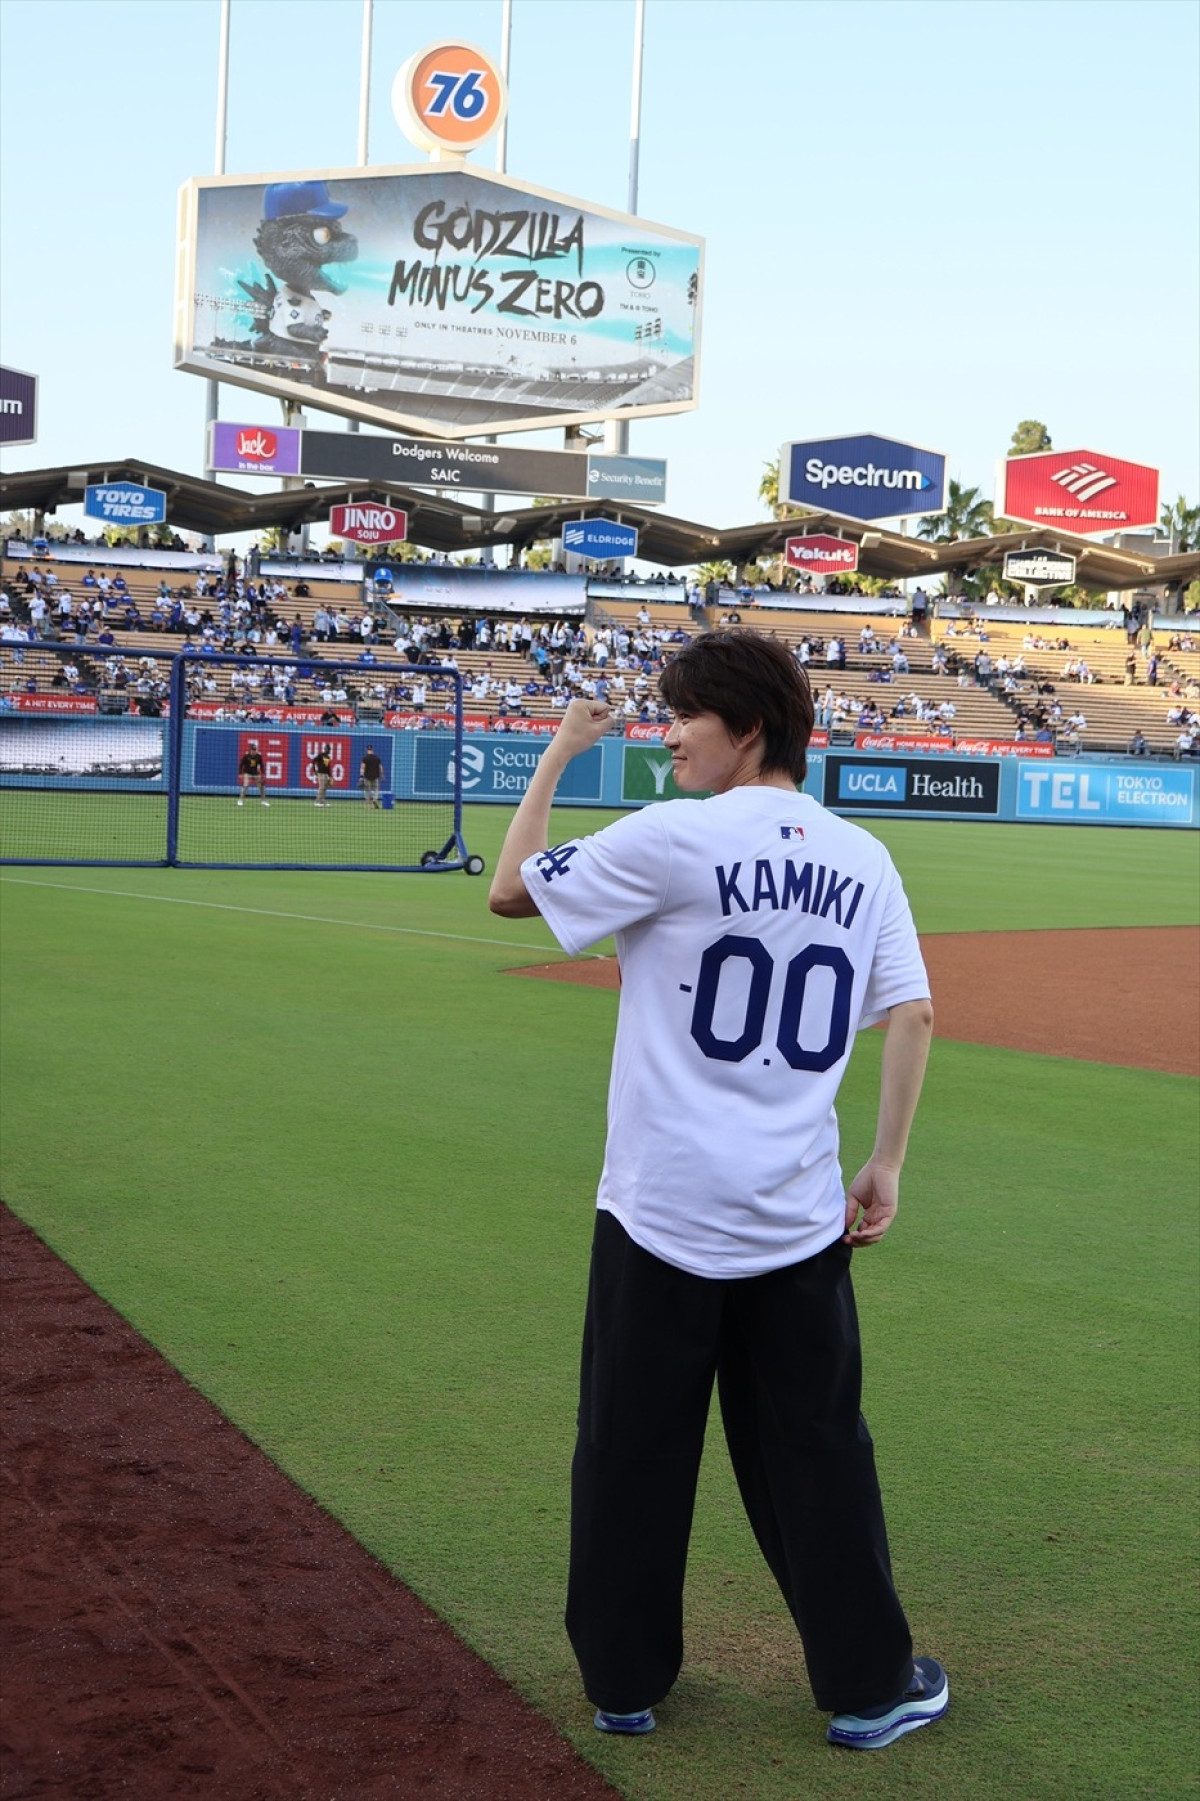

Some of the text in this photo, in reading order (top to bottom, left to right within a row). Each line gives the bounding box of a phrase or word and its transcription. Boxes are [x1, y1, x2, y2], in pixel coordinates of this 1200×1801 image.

[425, 70, 487, 121] 76
[413, 200, 584, 278] GODZILLA
[387, 259, 605, 320] MINUS ZERO
[414, 321, 436, 330] ONLY
[451, 324, 493, 336] THEATRES
[496, 327, 567, 345] NOVEMBER
[570, 335, 577, 345] 6
[237, 431, 276, 458] Jack
[393, 443, 499, 464] Dodgers Welcome
[431, 468, 461, 482] SAIC
[601, 472, 662, 486] Security Benefit
[805, 458, 922, 490] Spectrum
[95, 489, 145, 505] TOYO
[103, 503, 156, 519] TIRES
[1034, 506, 1128, 521] BANK OF AMERICA
[342, 508, 396, 533] JINRO
[357, 530, 379, 539] SOJU
[587, 534, 634, 546] ELDRIDGE
[790, 546, 854, 562] Yakult
[47, 701, 74, 709] EVERY
[75, 702, 95, 710] TIME
[862, 736, 896, 748] Coca-Cola
[957, 741, 990, 752] Coca-Cola
[492, 747, 542, 767] Secu
[305, 762, 345, 784] QO
[848, 774, 984, 799] UCLA Health
[1024, 772, 1100, 810] TEL
[1117, 775, 1162, 790] TOKYO
[1117, 790, 1188, 806] ELECTRON
[715, 859, 865, 930] KAMIKI
